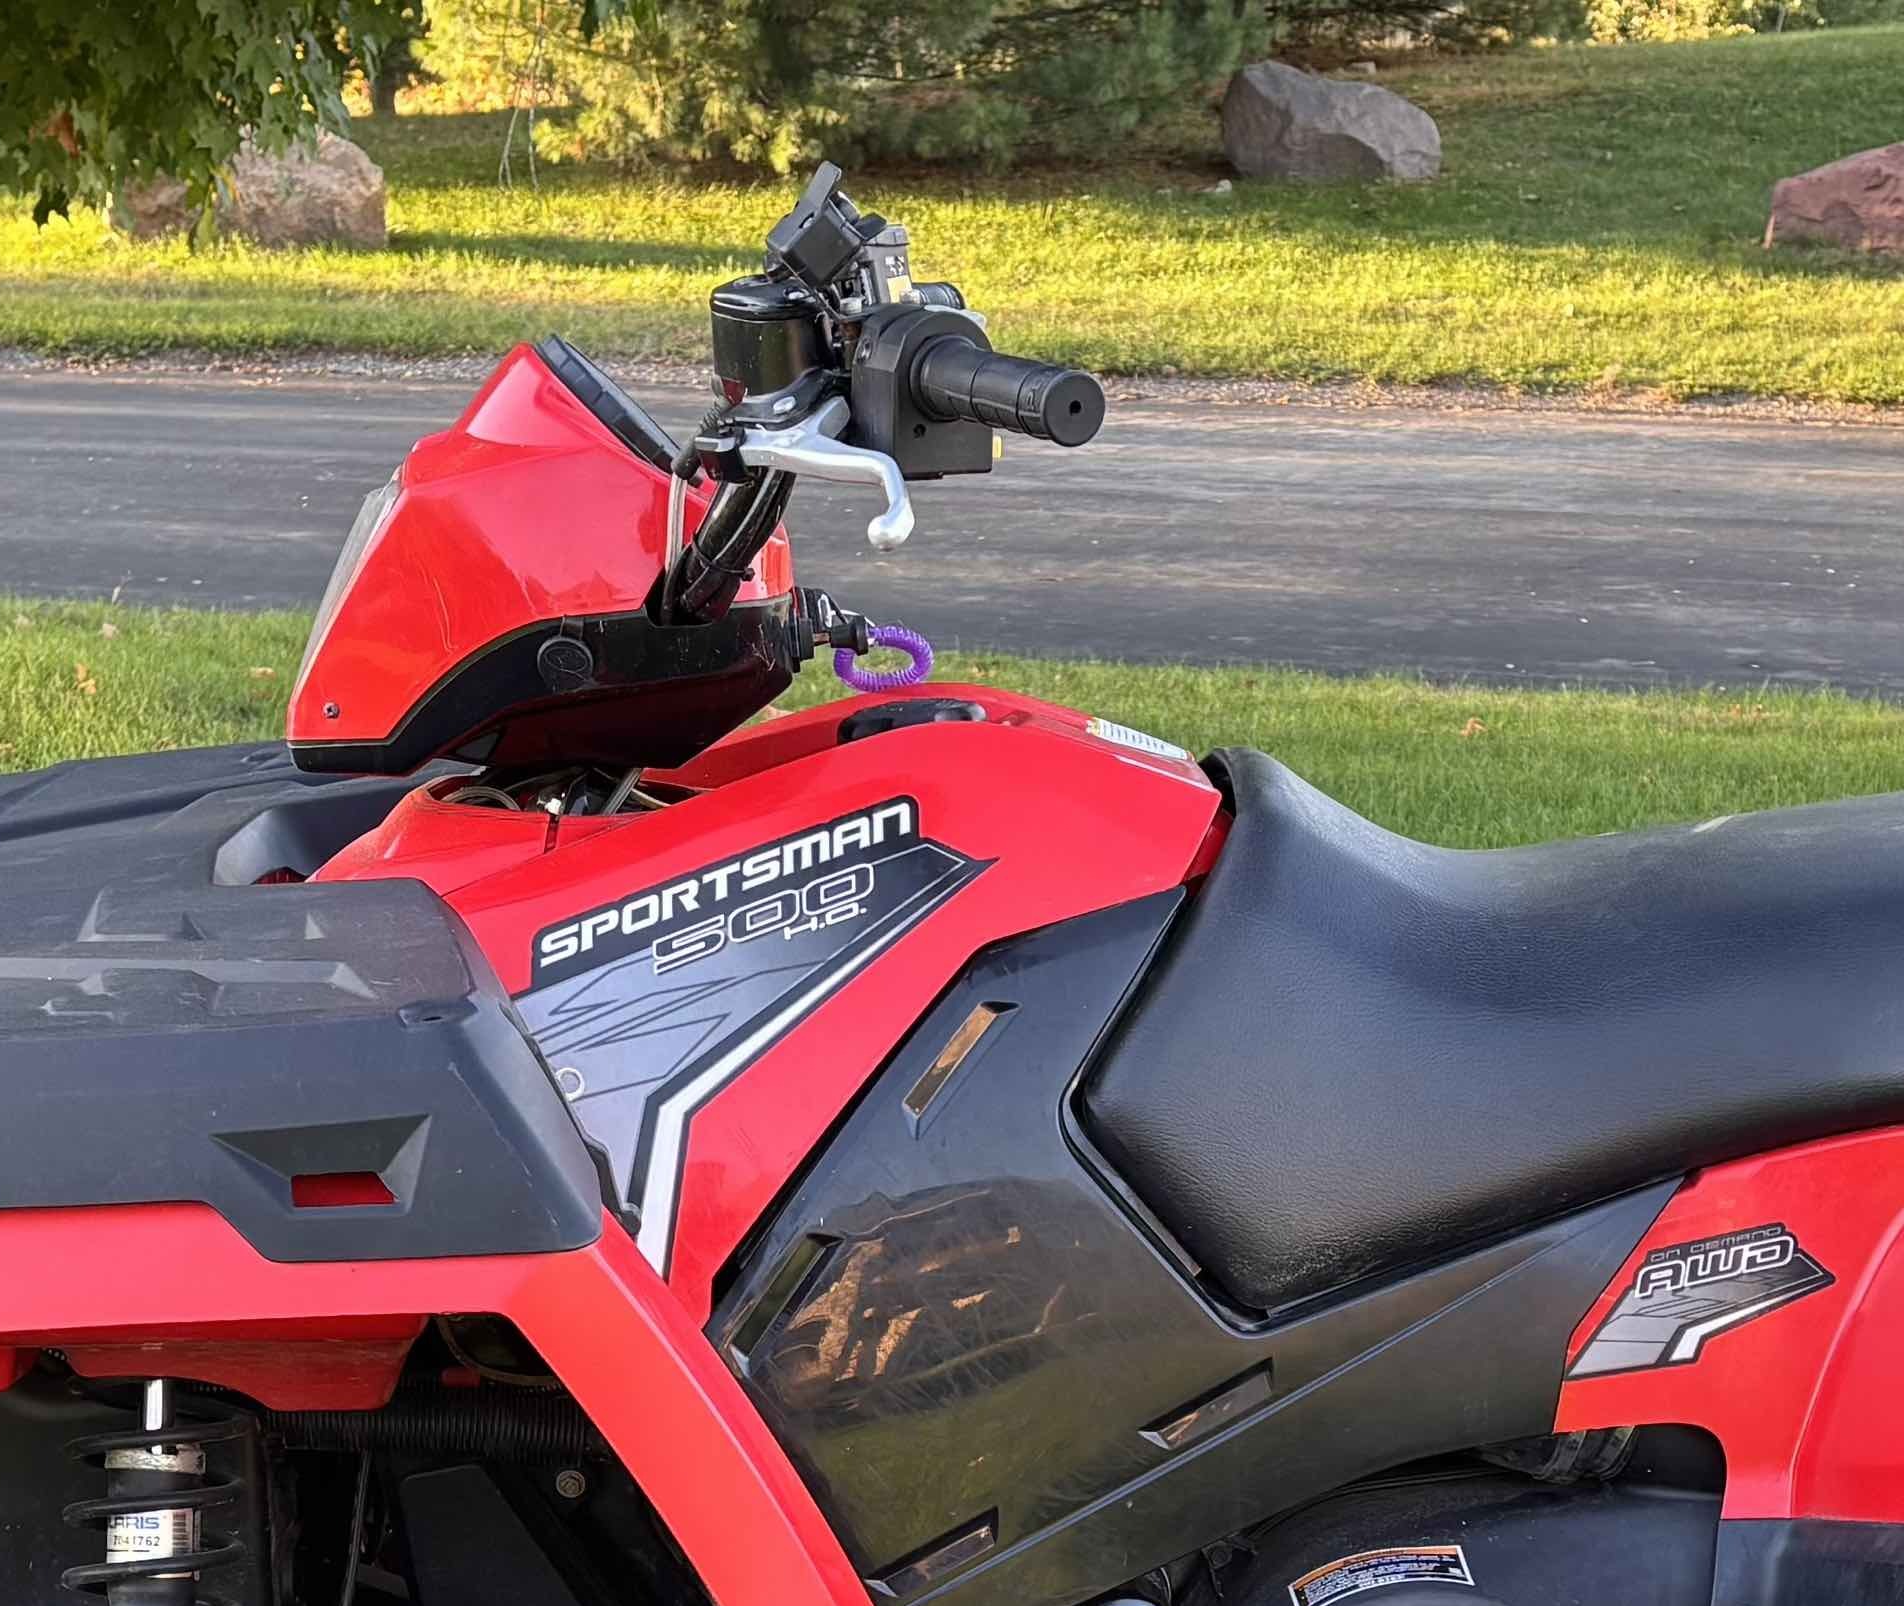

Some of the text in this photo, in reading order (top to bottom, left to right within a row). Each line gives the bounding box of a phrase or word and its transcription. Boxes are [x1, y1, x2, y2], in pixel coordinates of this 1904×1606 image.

[540, 801, 912, 968] SPORTSMAN
[651, 862, 874, 976] 500
[783, 902, 868, 940] H.O.
[1634, 1235, 1795, 1298] AWD
[1649, 1226, 1782, 1263] ON DEMAND
